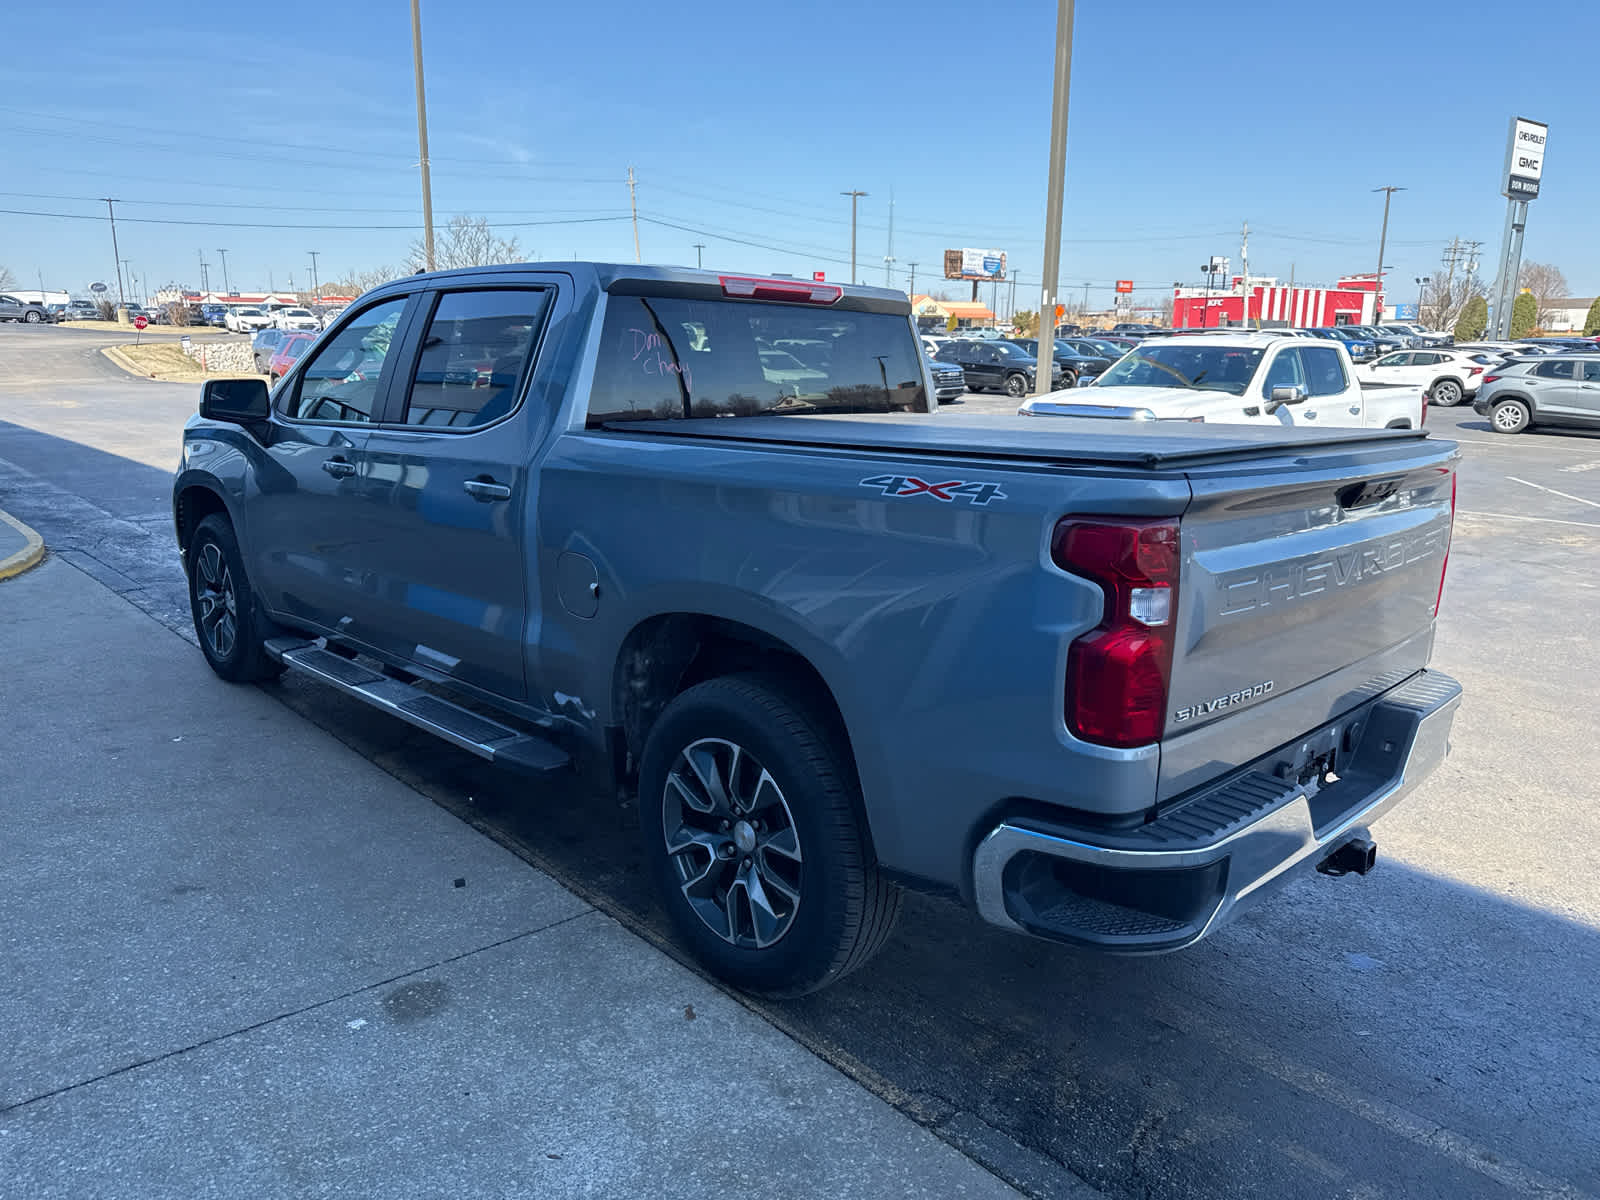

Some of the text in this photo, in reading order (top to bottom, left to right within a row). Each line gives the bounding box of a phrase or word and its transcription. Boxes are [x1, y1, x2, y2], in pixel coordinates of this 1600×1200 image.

[1518, 156, 1539, 171] GMC
[1207, 298, 1224, 307] KFC
[1215, 524, 1450, 616] CHEVROLET
[1174, 679, 1275, 723] SILVERADO
